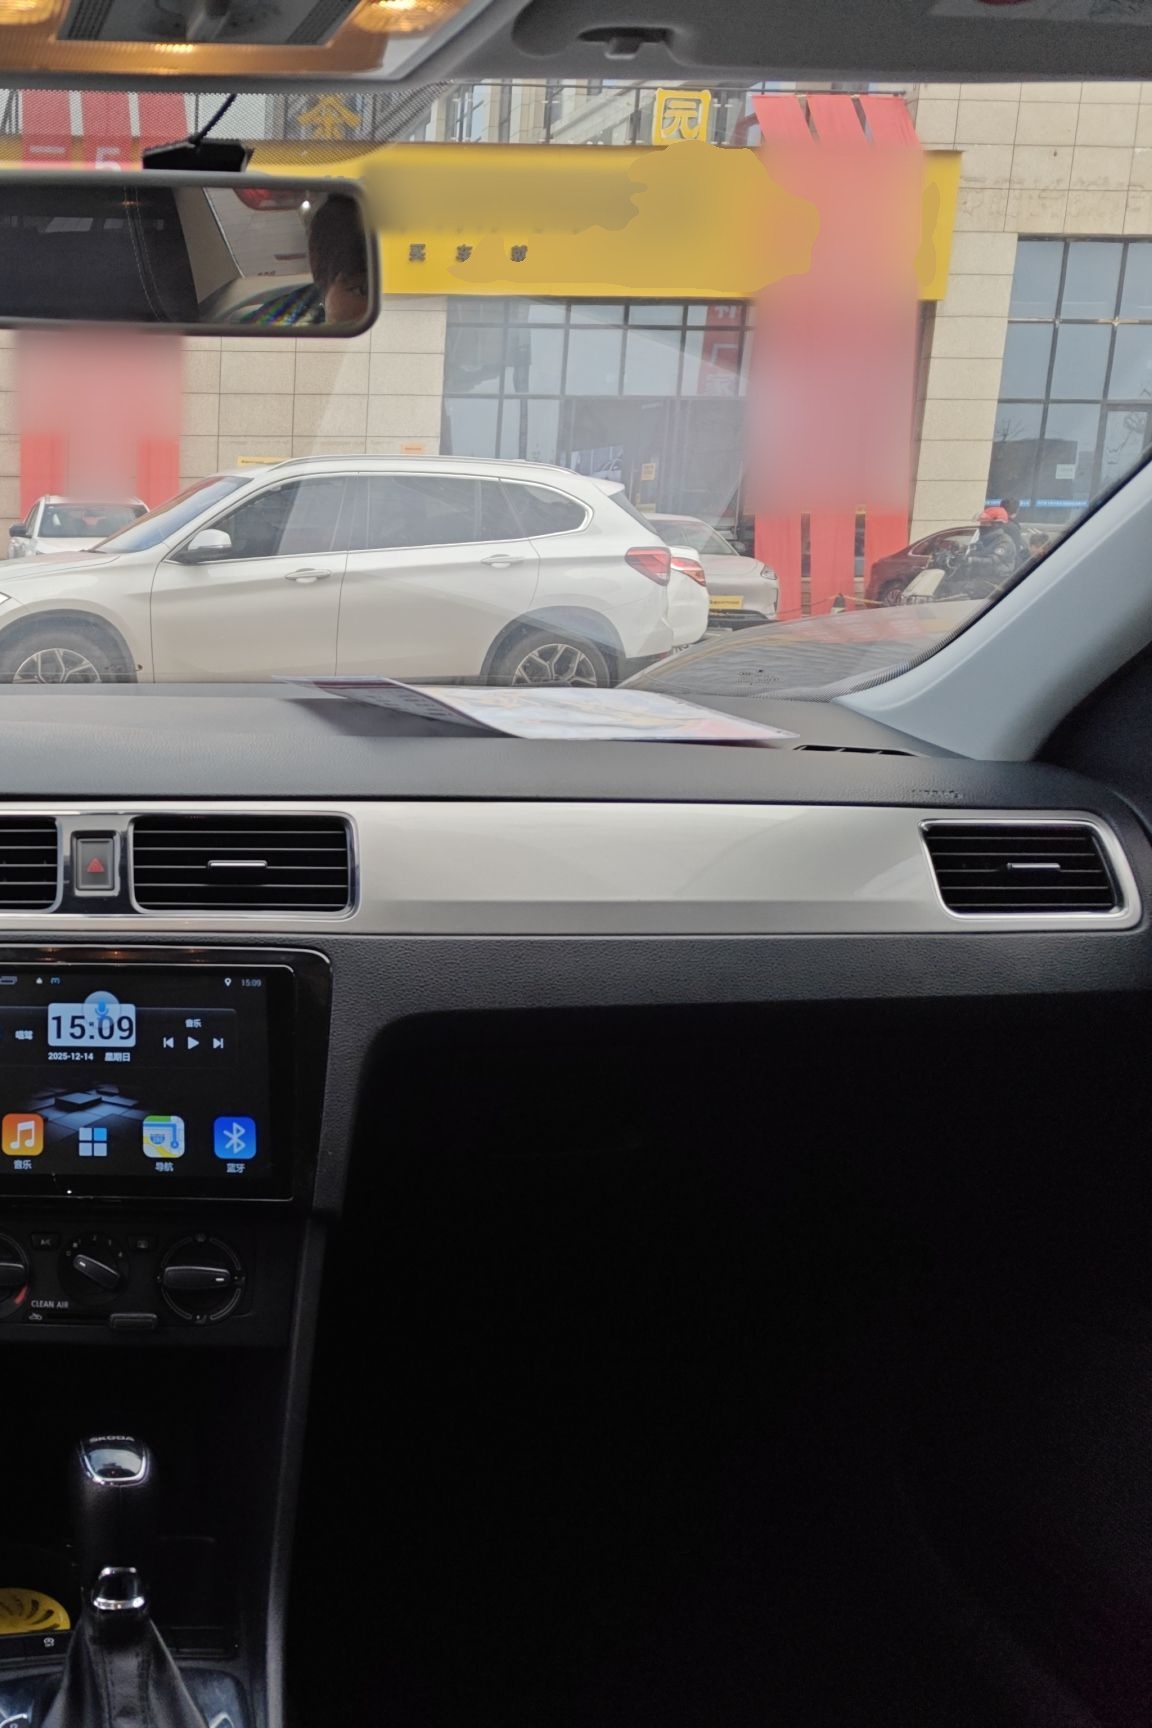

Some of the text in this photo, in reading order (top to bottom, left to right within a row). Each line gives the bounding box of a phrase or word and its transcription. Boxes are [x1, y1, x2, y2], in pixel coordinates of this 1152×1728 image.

[653, 88, 712, 145] 园
[241, 979, 262, 987] 15:09
[51, 1015, 134, 1040] 15:09
[185, 1018, 202, 1028] 音乐
[48, 1052, 131, 1062] 2025-12-14 星期日
[14, 1159, 32, 1170] 音乐
[155, 1162, 174, 1172] 导航
[226, 1163, 246, 1173] 蓝牙
[31, 1300, 69, 1309] CLEAN AIR
